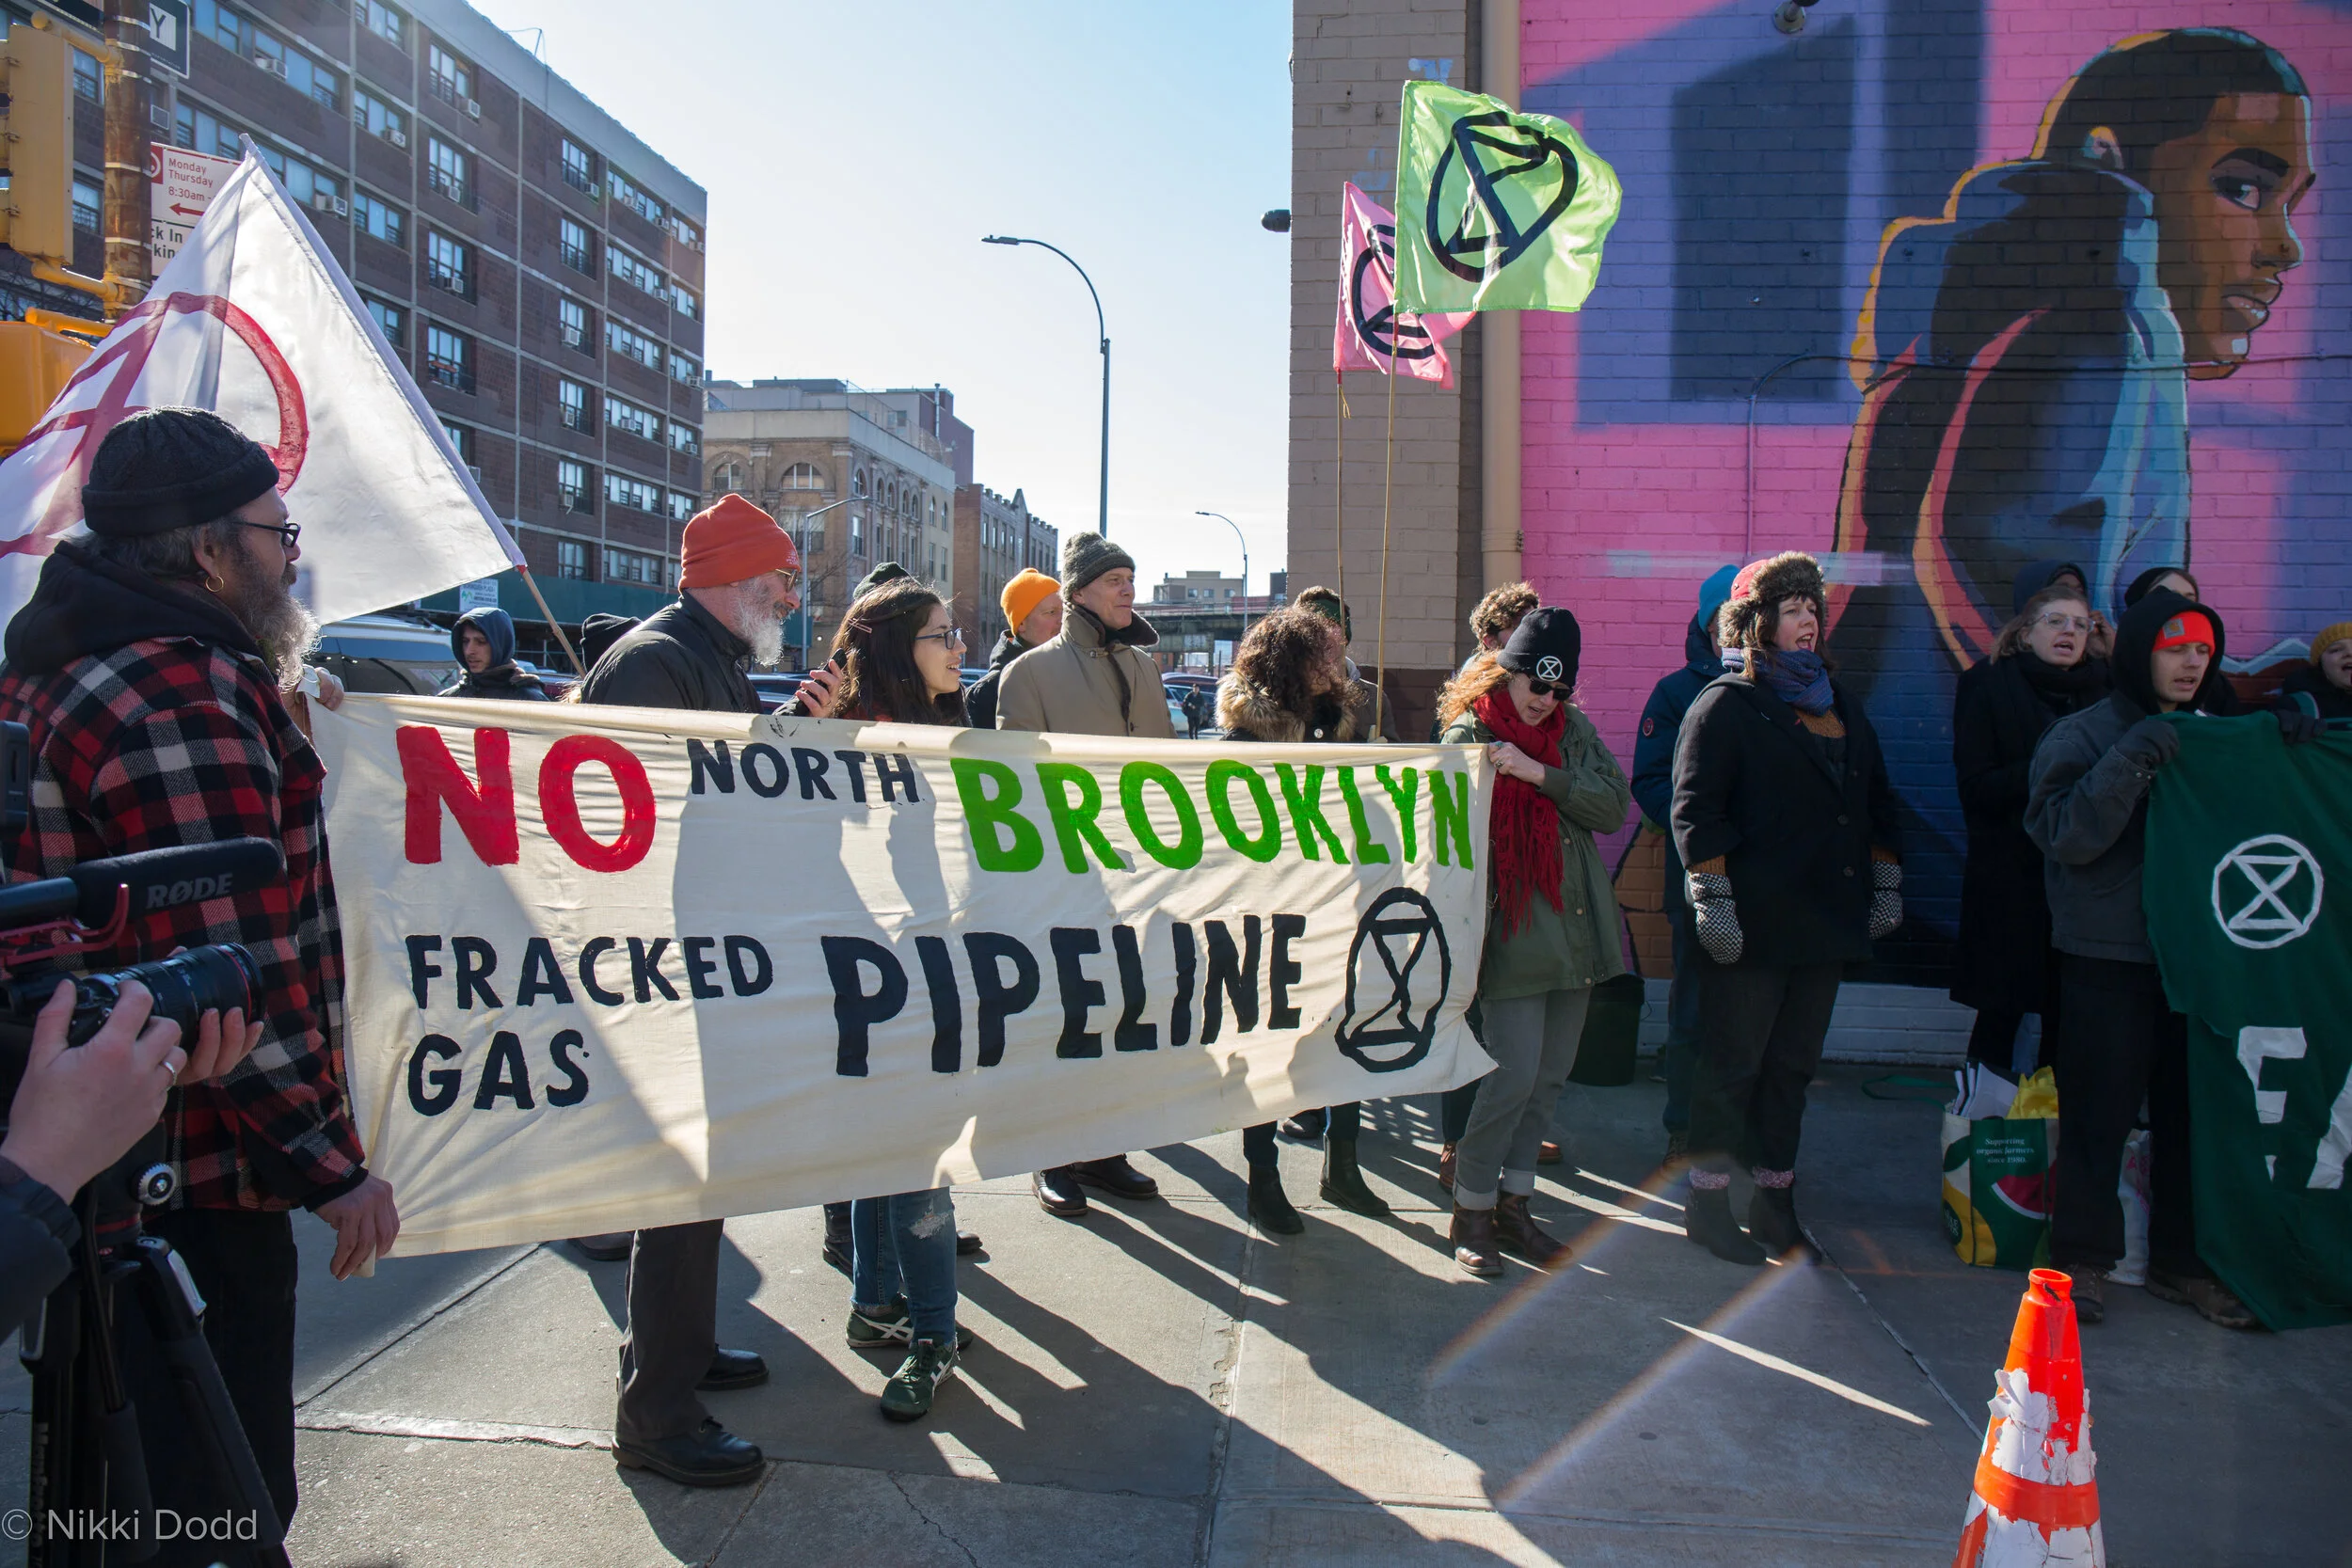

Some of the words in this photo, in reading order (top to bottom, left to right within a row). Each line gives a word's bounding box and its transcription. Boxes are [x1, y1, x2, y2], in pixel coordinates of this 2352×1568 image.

[168, 157, 207, 175] Monday
[168, 169, 214, 188] Thursday
[168, 186, 205, 201] 8:30am
[169, 229, 183, 244] In
[396, 726, 657, 873] NO
[686, 738, 920, 803] NORTH
[949, 758, 1475, 875] BROOKLYN
[405, 934, 774, 1010] FRACKED
[820, 913, 1307, 1077] PIPELINE
[407, 1029, 590, 1117] GAS
